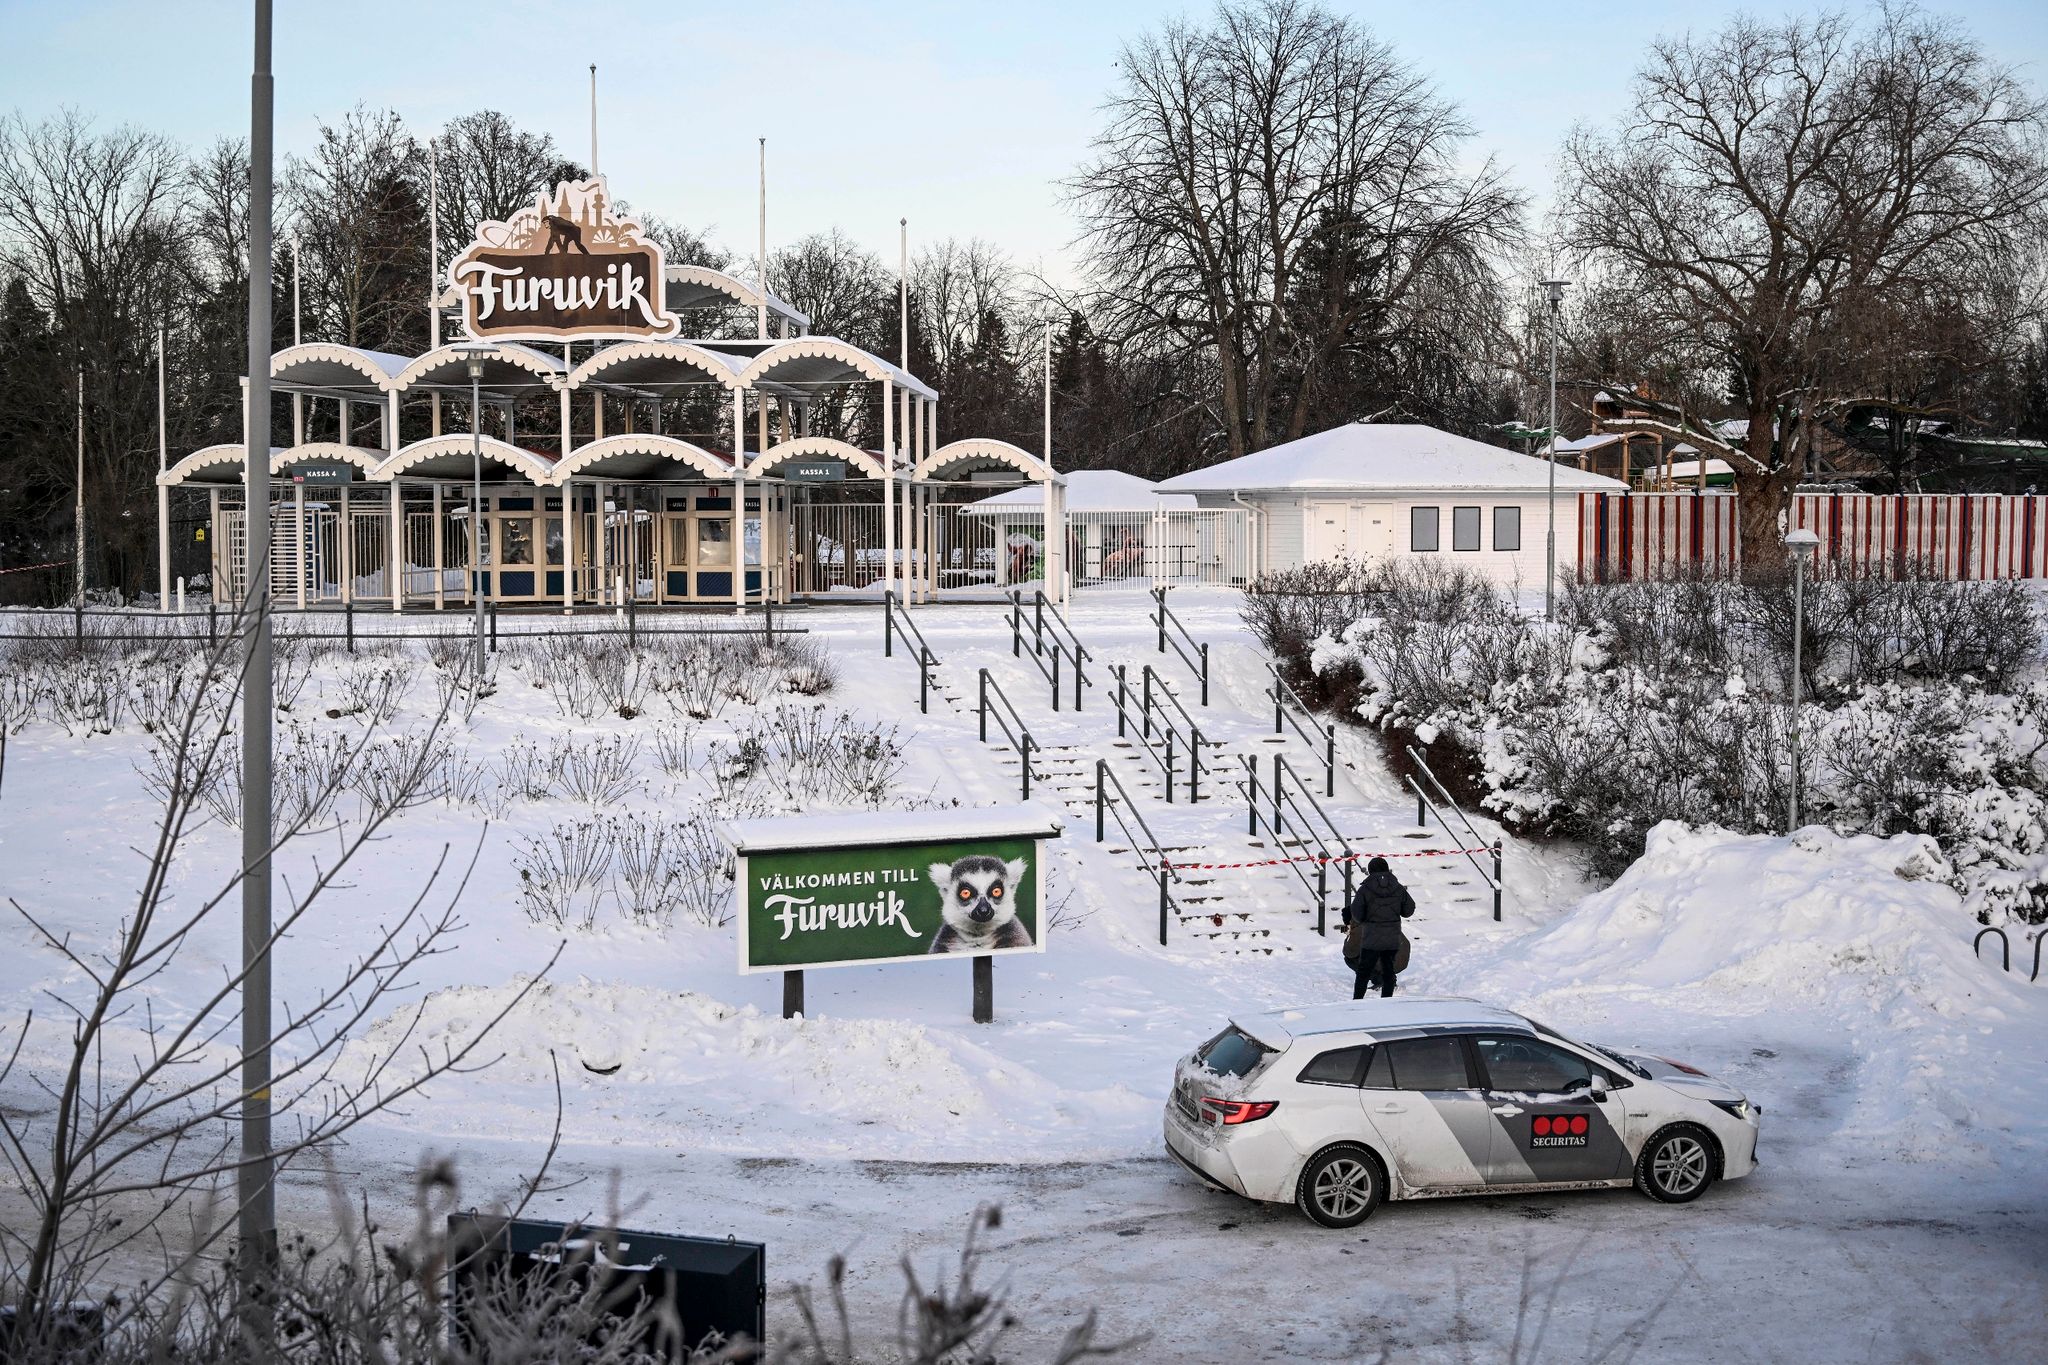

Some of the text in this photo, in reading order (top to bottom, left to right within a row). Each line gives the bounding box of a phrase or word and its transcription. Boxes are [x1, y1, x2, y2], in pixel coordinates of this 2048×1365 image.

[457, 262, 669, 328] Furuvik
[760, 868, 919, 891] VÄLKOMMEN TILL
[764, 890, 922, 940] Furuvik
[1533, 1136, 1586, 1147] SECURITAS
